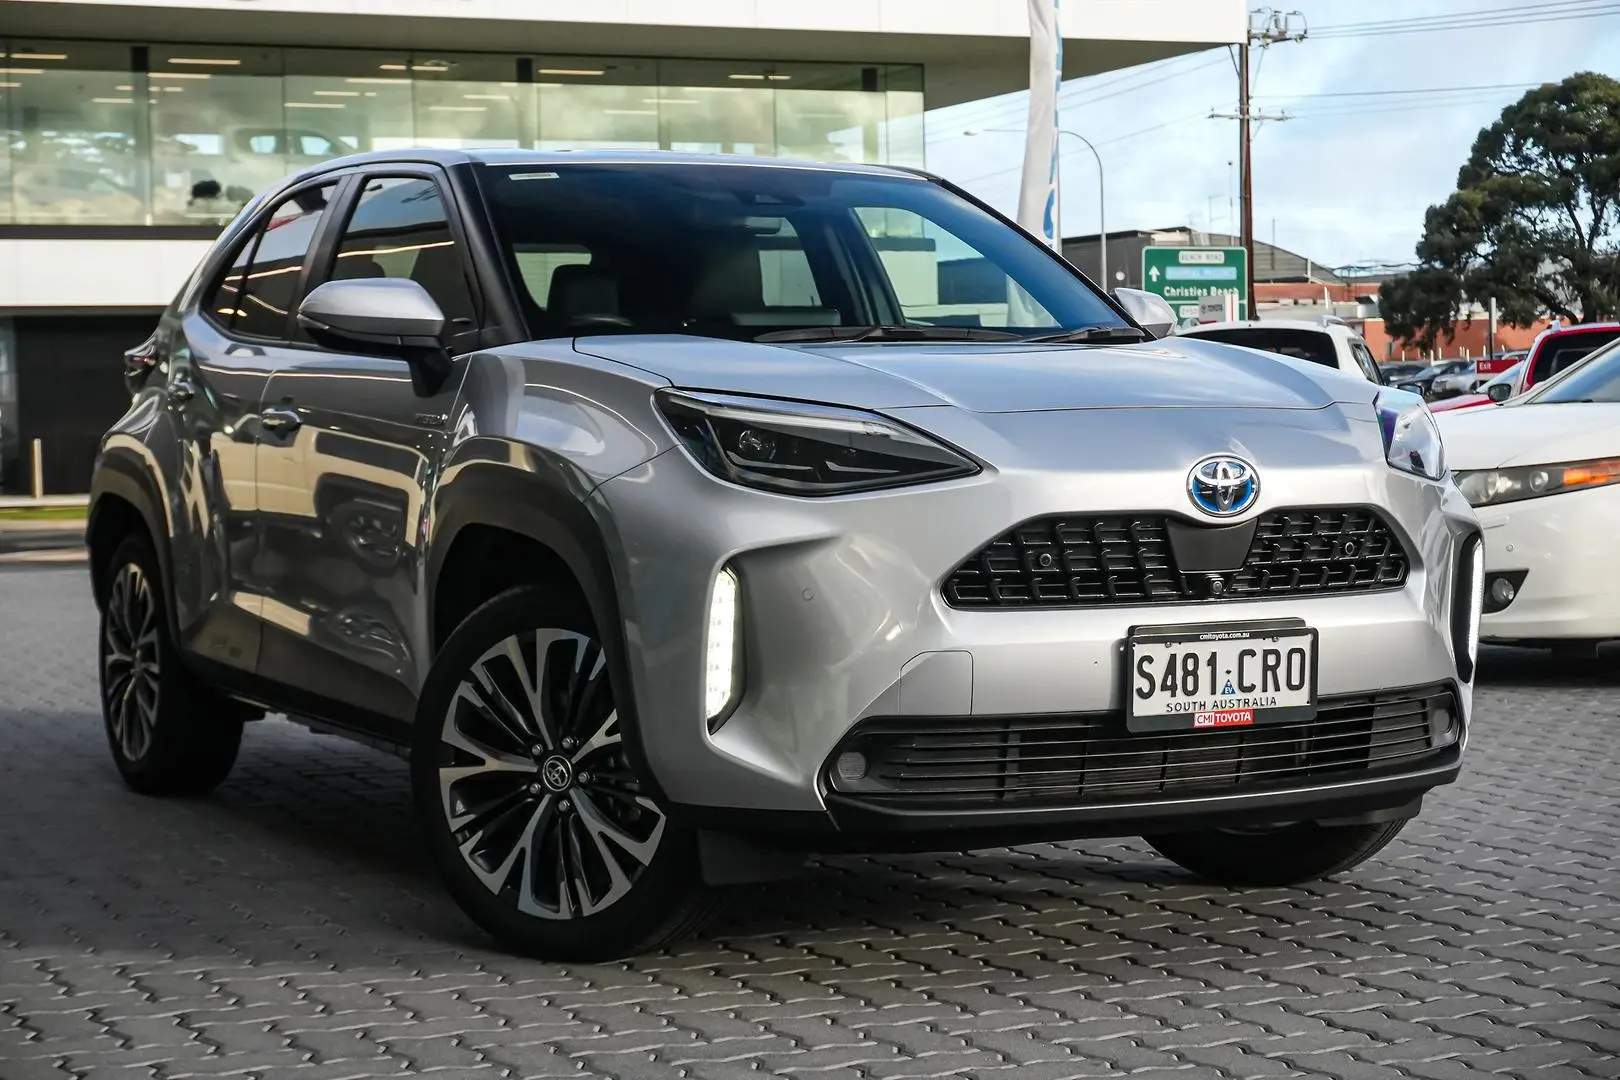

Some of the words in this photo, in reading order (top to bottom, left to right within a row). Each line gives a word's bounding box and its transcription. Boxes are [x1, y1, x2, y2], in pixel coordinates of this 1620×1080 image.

[1479, 362, 1492, 370] Exit
[1199, 632, 1250, 641] cmitoyota.com.au
[1166, 701, 1206, 713] SOUTH
[1212, 697, 1277, 710] AUSTRALIA
[1196, 711, 1213, 725] CMI
[1215, 711, 1251, 724] TOYOTA
